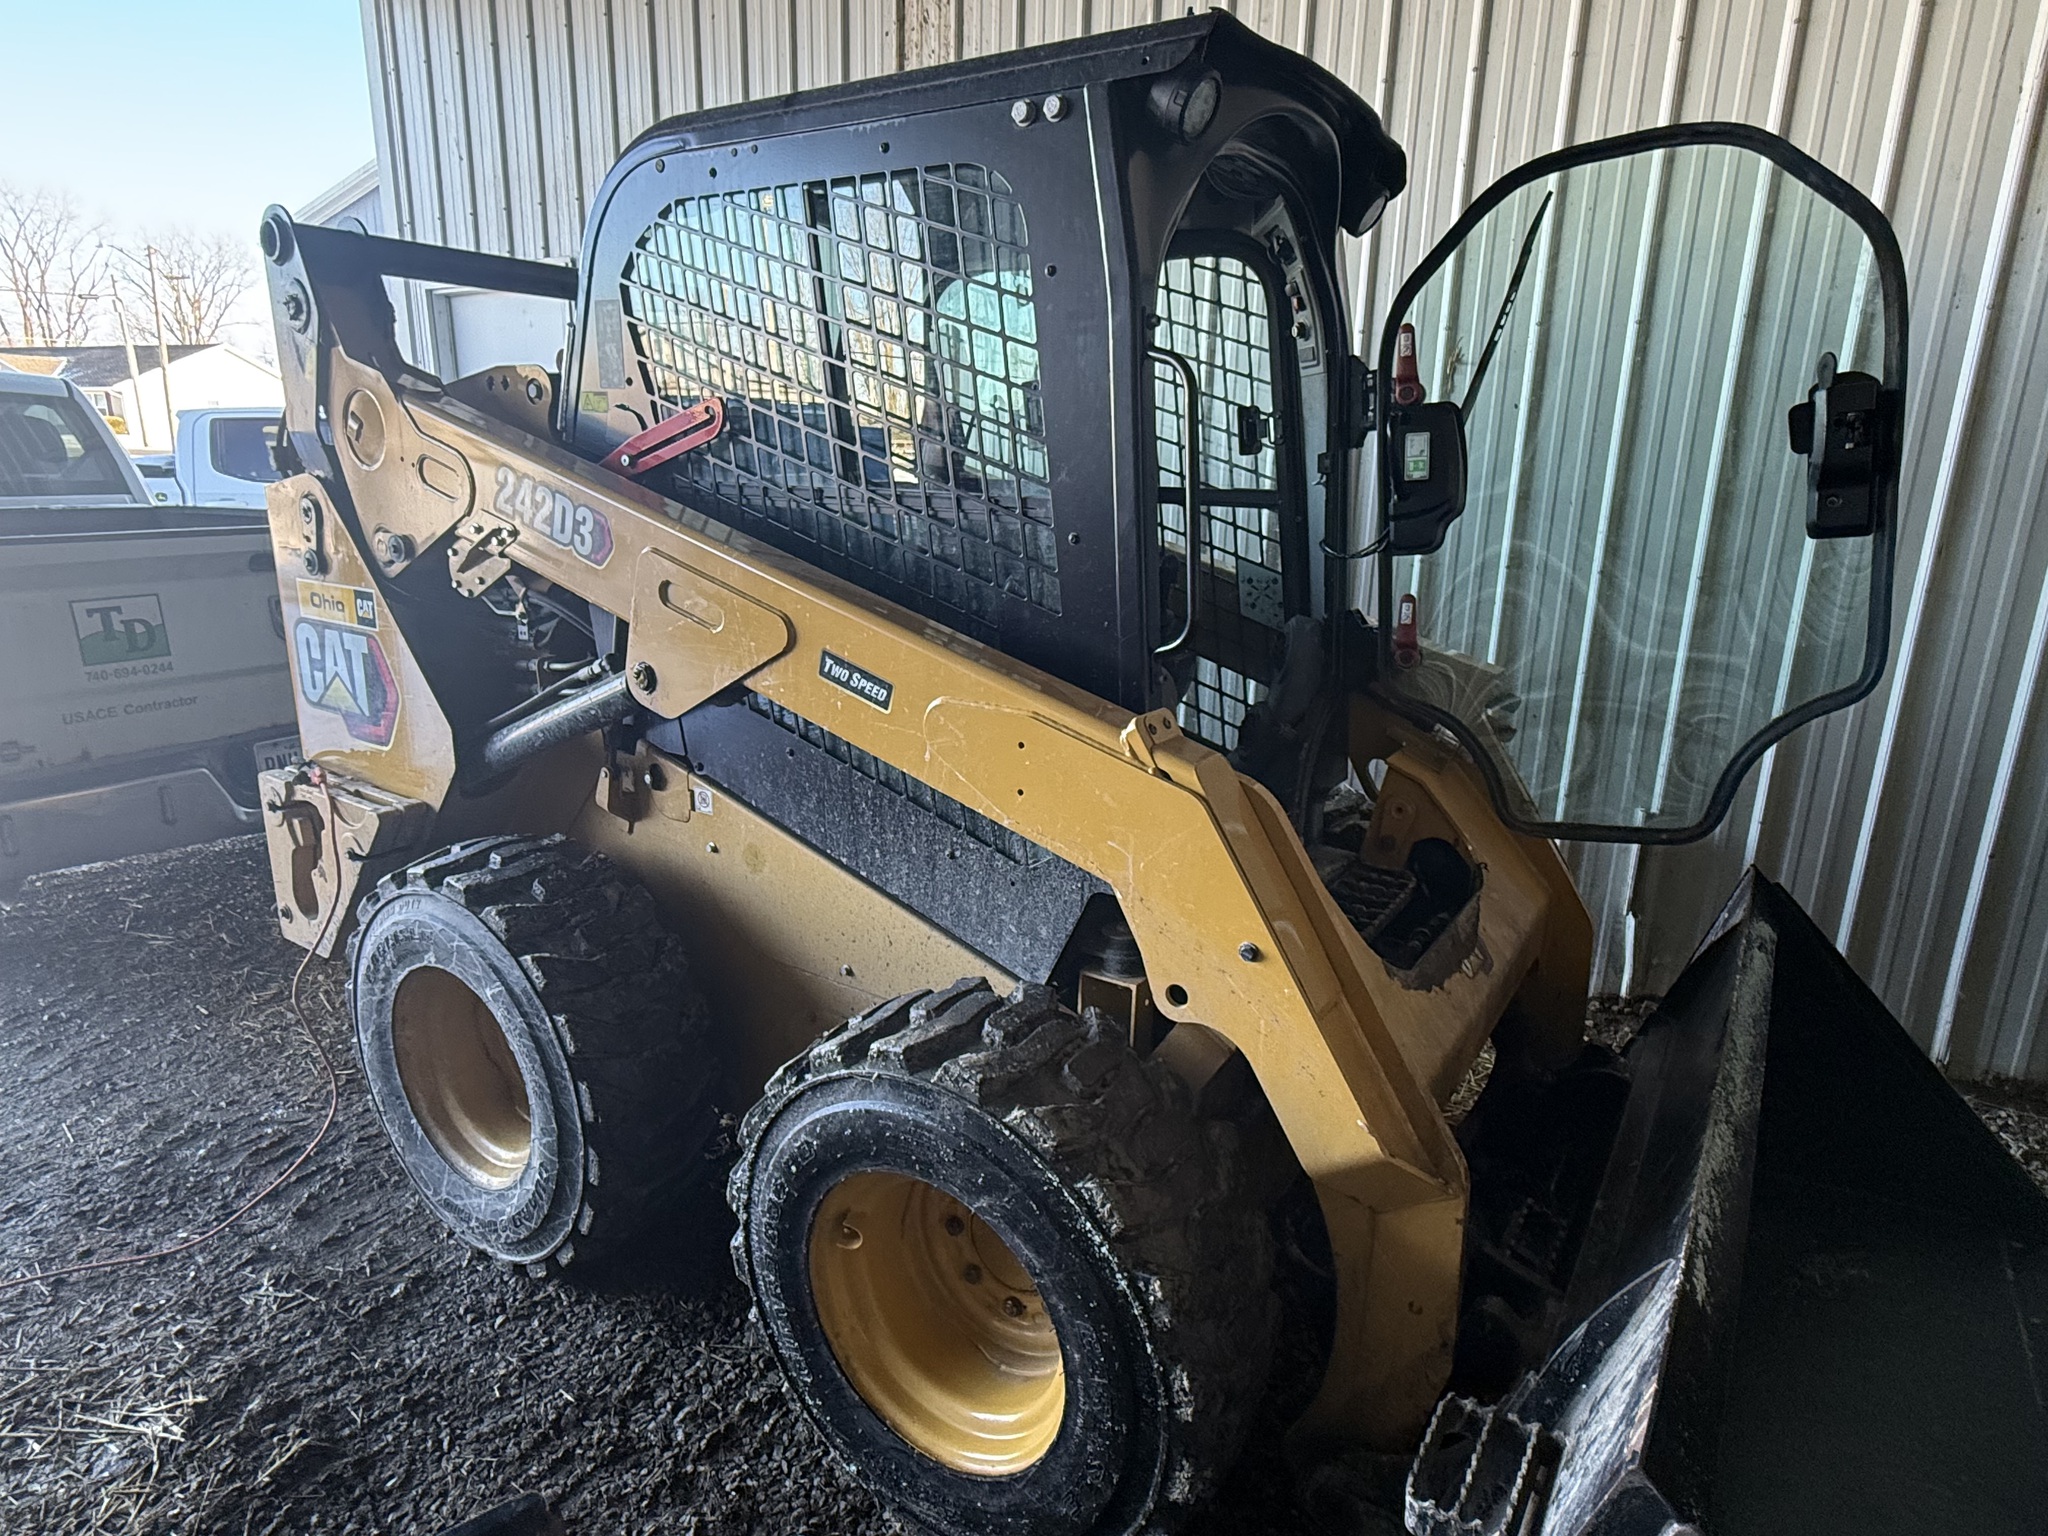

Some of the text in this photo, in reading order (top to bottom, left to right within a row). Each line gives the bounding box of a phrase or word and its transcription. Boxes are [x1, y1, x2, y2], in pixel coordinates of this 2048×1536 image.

[496, 466, 594, 555] 242D3
[310, 591, 374, 619] Ohio CAT
[84, 661, 174, 682] 740-694-0244
[296, 622, 370, 716] CAT
[61, 696, 199, 725] USACE Contractor
